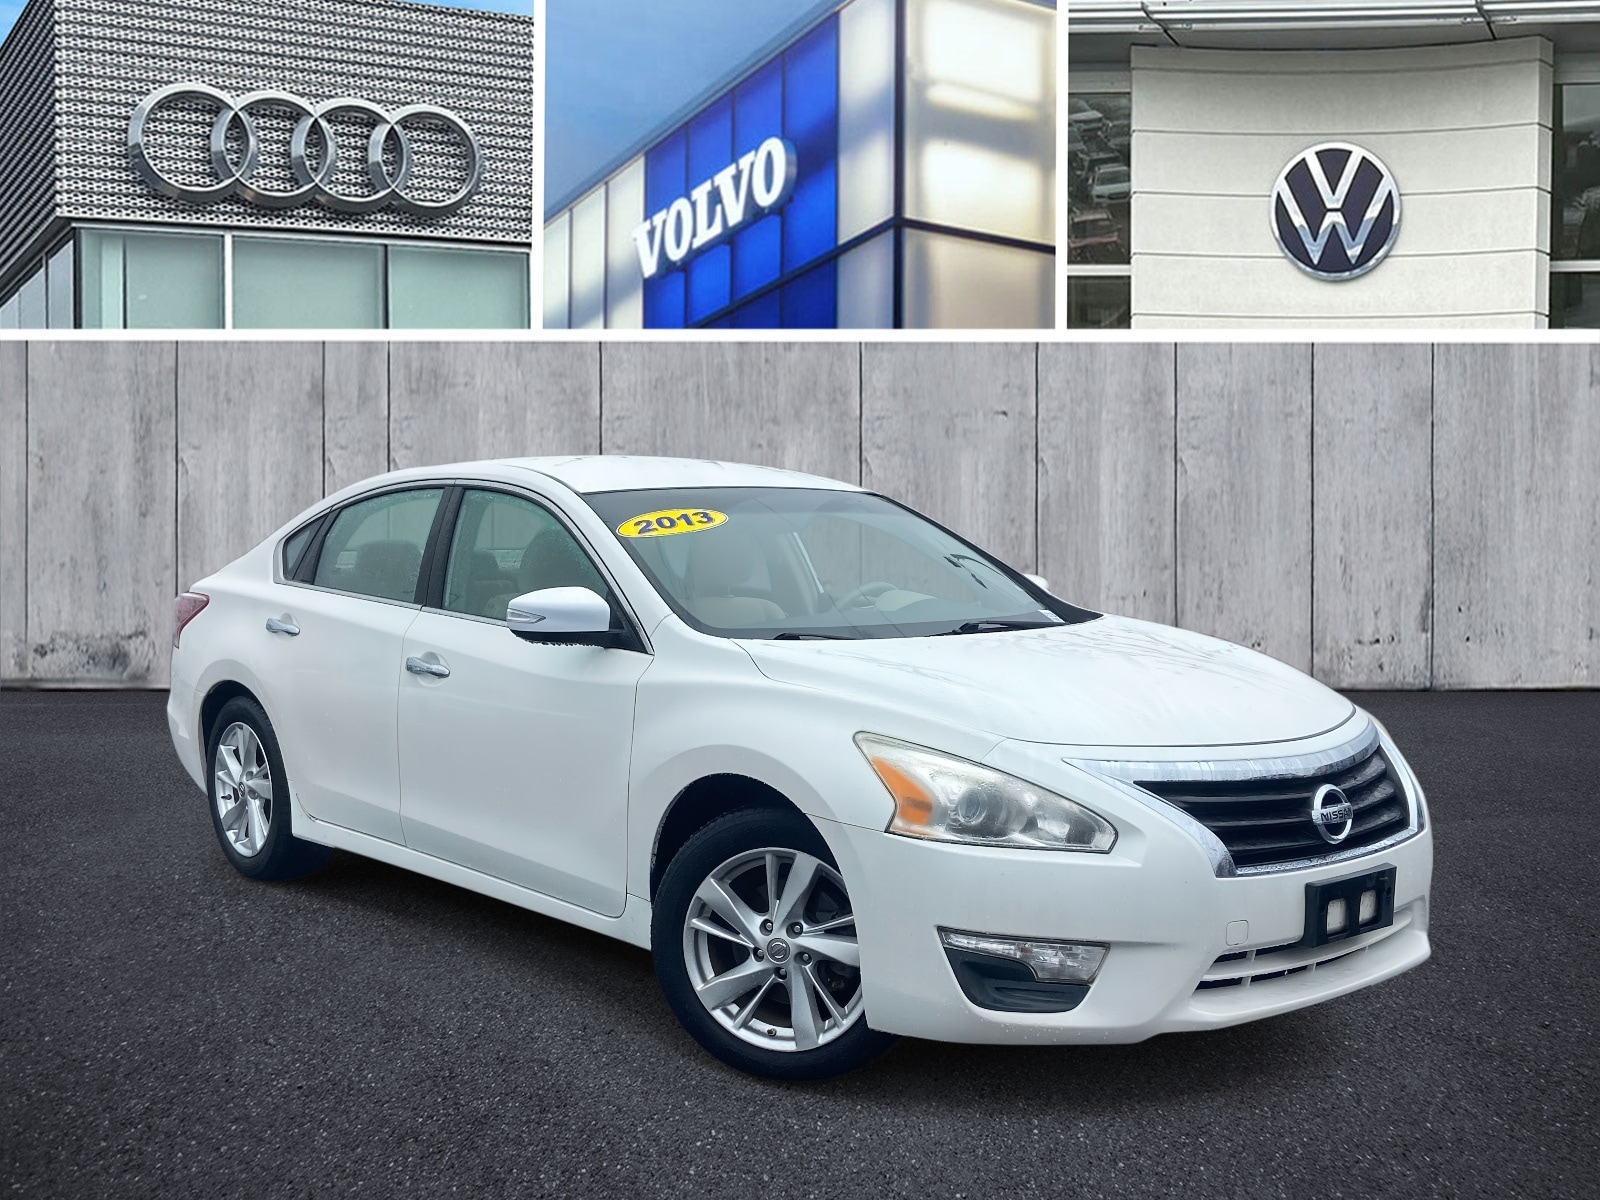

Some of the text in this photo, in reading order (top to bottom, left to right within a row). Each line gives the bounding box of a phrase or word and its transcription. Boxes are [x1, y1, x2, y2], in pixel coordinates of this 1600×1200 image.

[633, 137, 787, 279] VOLVO
[633, 511, 715, 535] 2013
[1320, 807, 1352, 822] NISSAN
